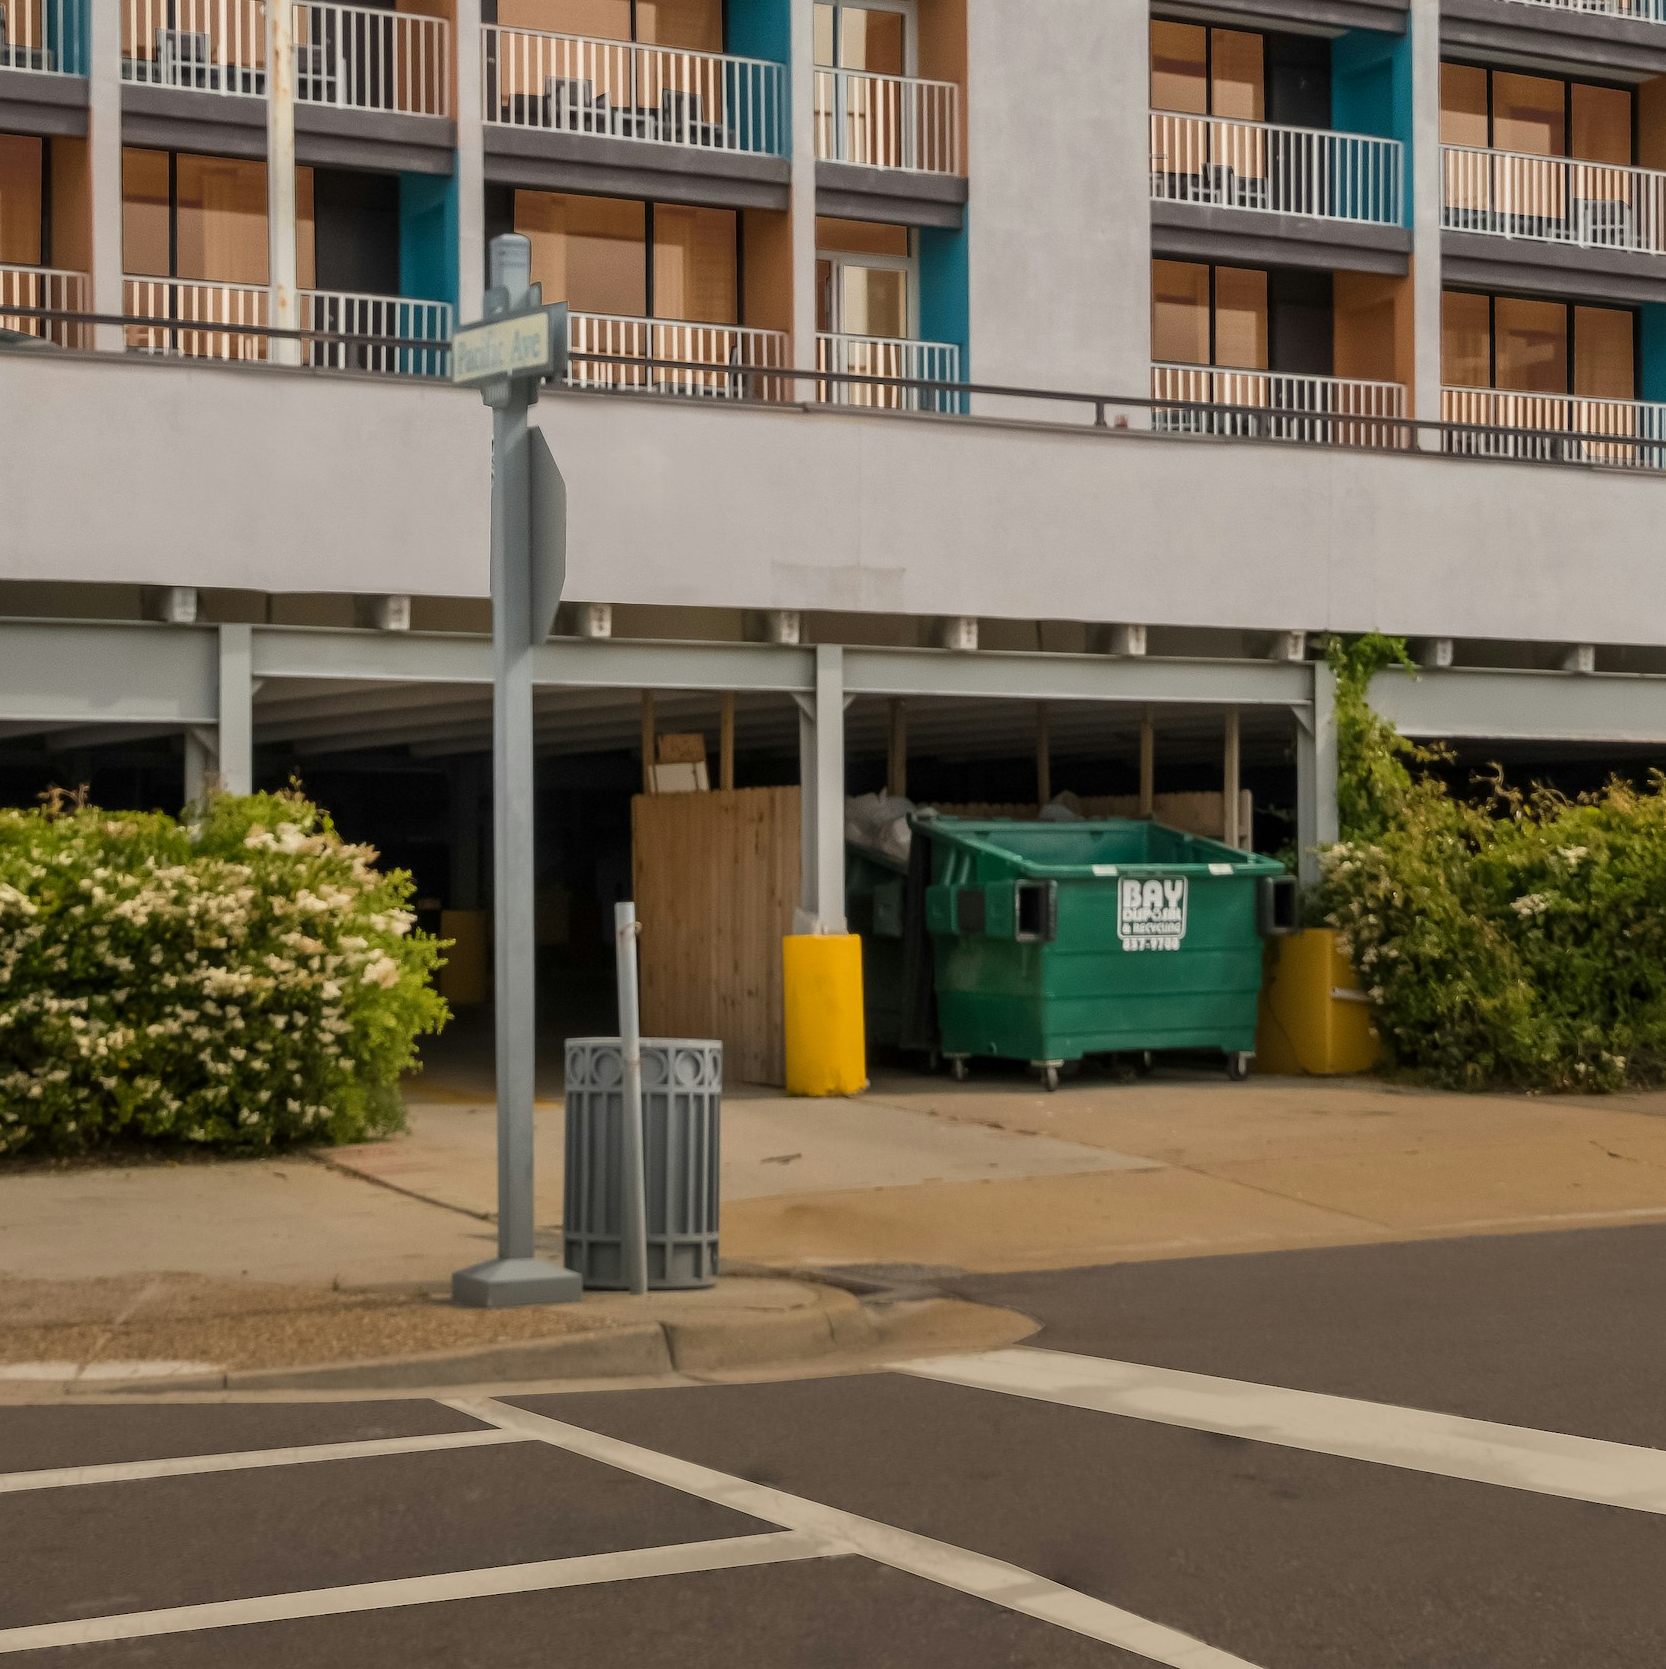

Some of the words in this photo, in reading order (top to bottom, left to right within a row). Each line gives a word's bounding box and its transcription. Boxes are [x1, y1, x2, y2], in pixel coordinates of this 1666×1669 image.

[511, 331, 541, 363] Ave
[1123, 879, 1183, 907] BAY
[1133, 922, 1180, 934] RECYCLING
